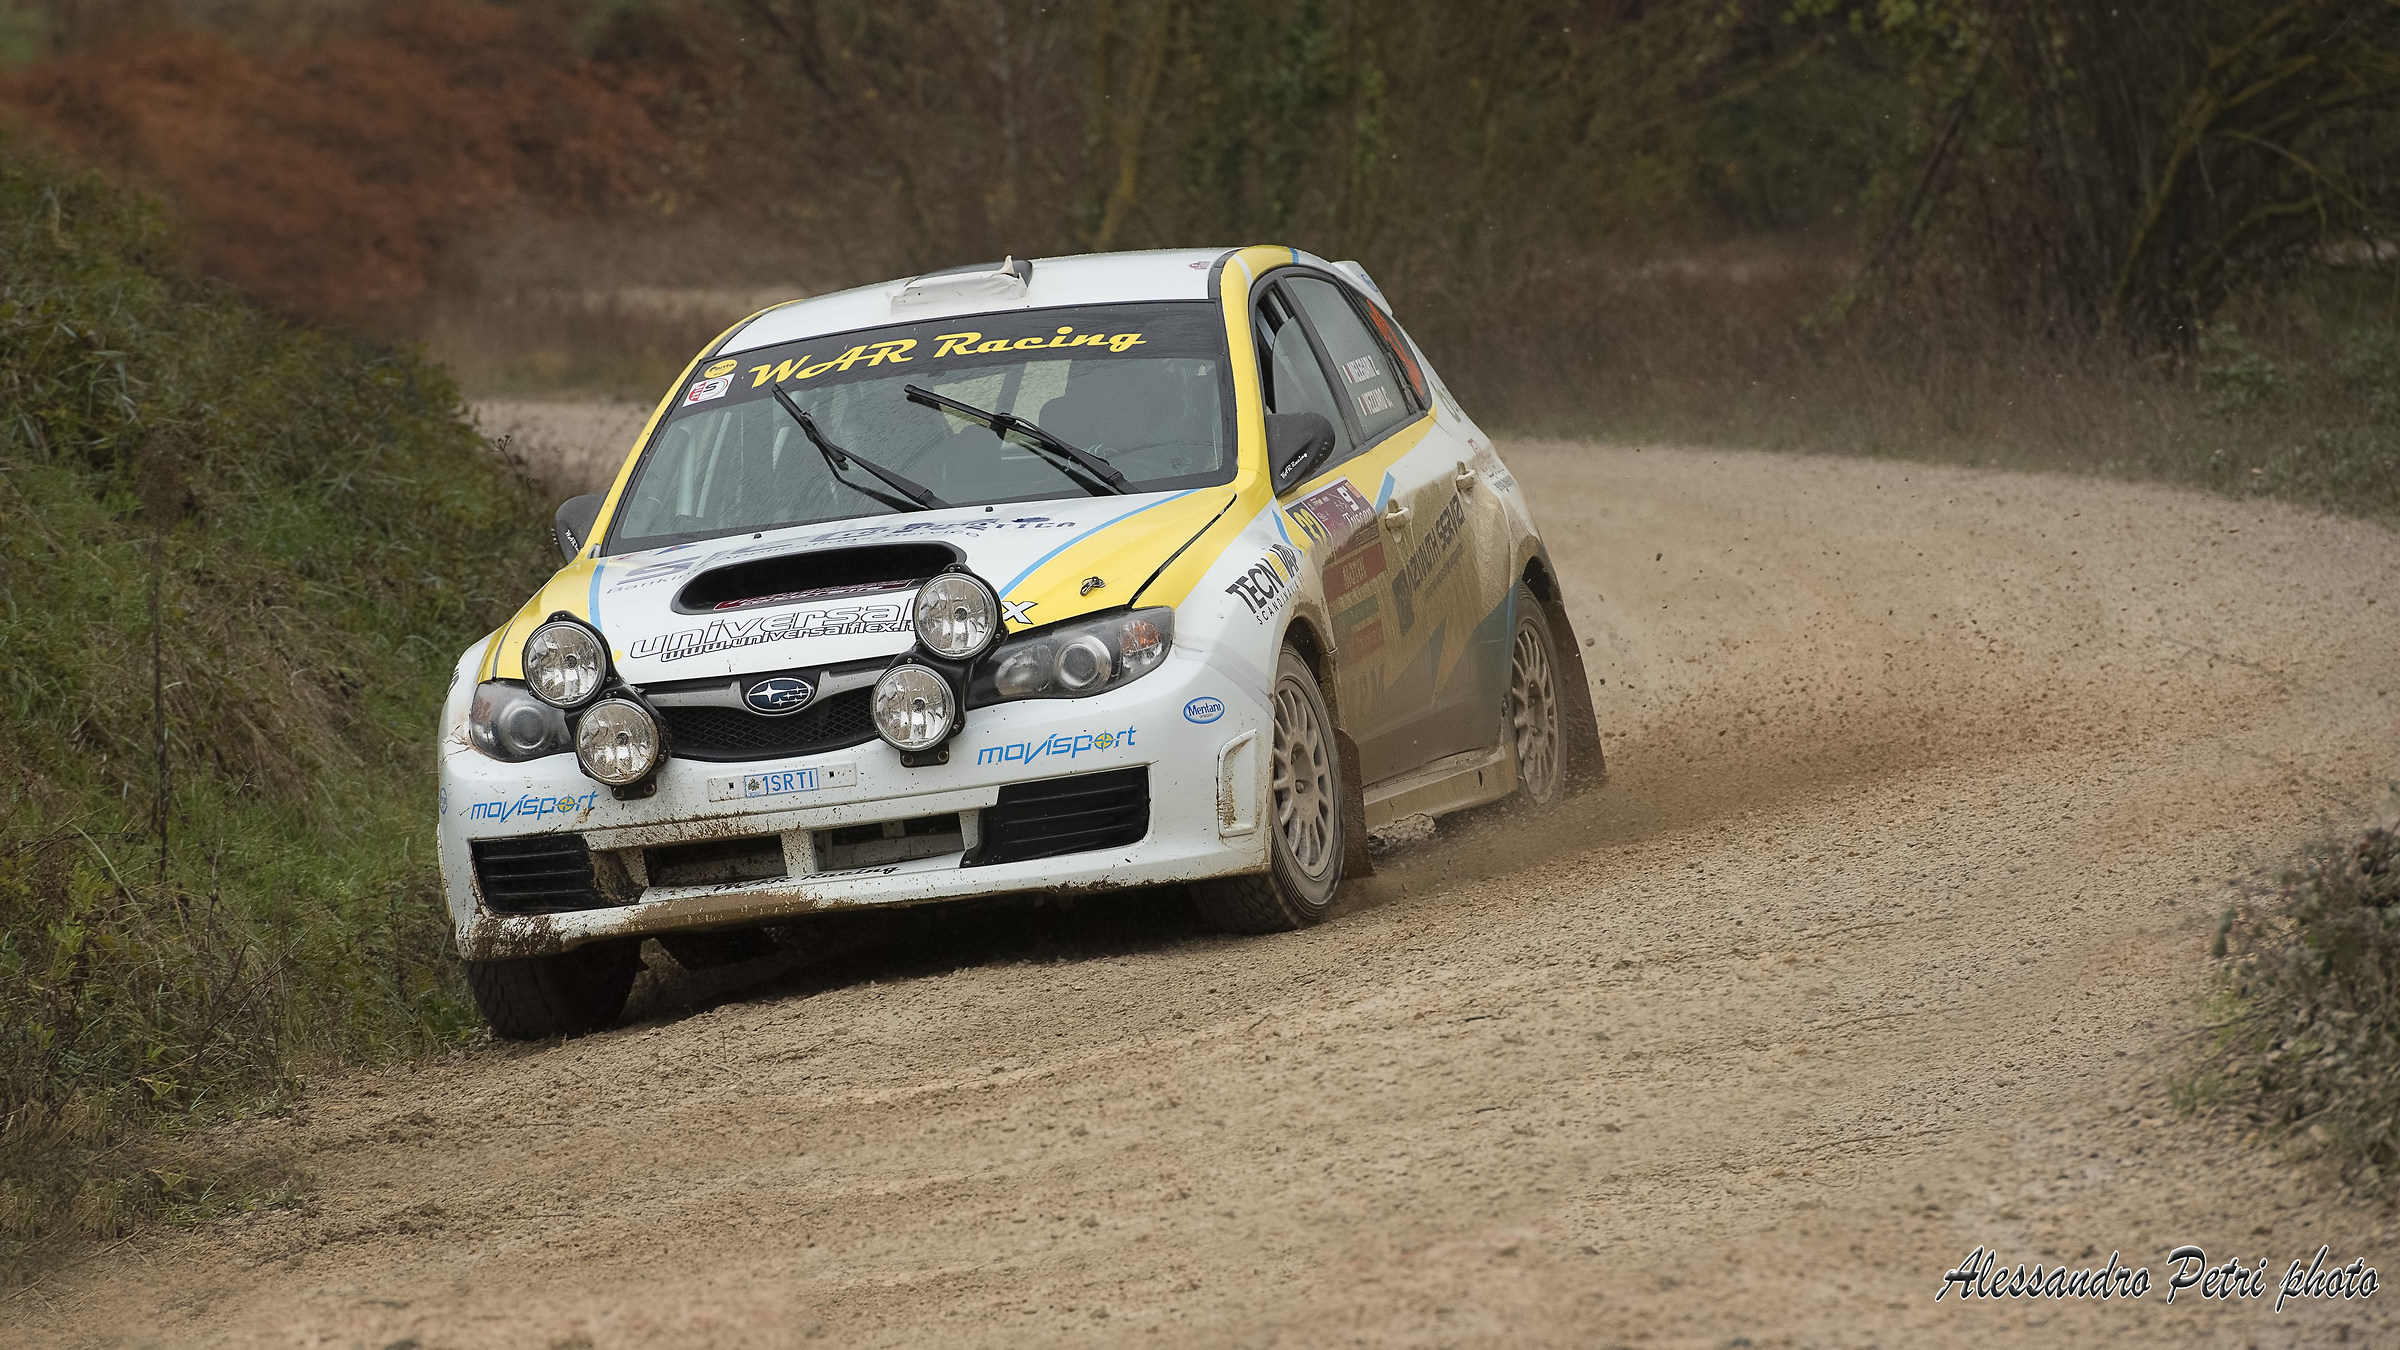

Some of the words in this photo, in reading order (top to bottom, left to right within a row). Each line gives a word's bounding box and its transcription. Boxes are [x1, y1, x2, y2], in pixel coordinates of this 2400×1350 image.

[749, 339, 917, 389] WAR
[933, 326, 1147, 357] Racing
[1188, 702, 1222, 717] Mentani
[977, 725, 1137, 765] movisport
[470, 790, 599, 823] movisport
